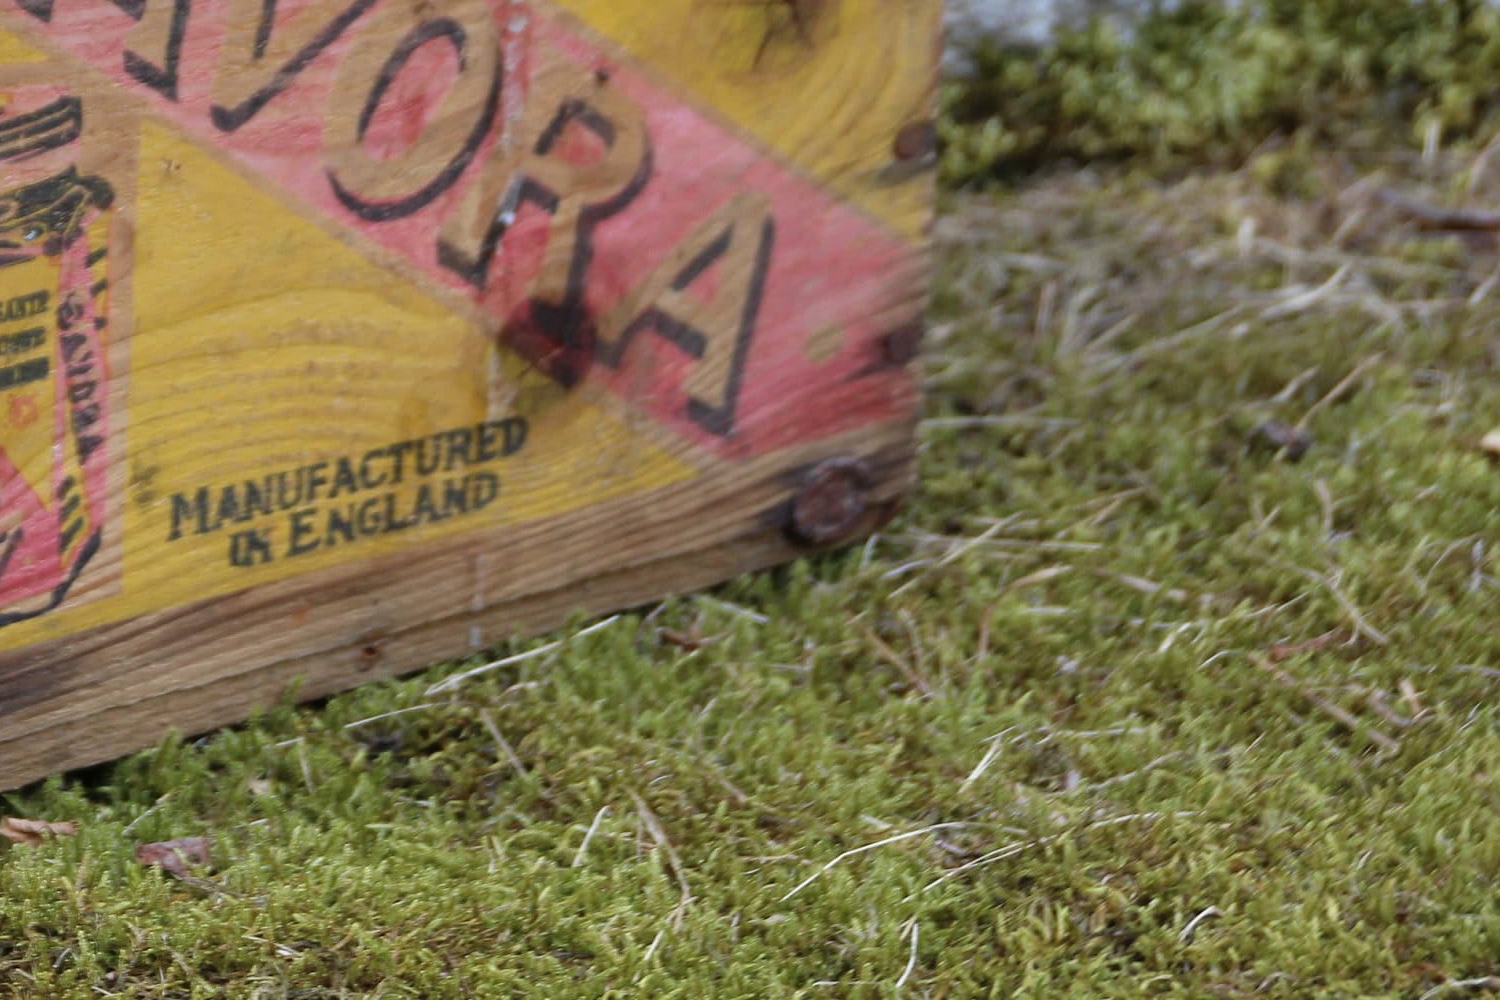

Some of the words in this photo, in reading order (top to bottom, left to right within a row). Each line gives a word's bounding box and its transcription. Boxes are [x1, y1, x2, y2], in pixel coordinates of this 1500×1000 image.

[166, 415, 530, 542] MANUFACTURED
[228, 526, 272, 566] IN
[285, 472, 499, 557] ENGLAND
